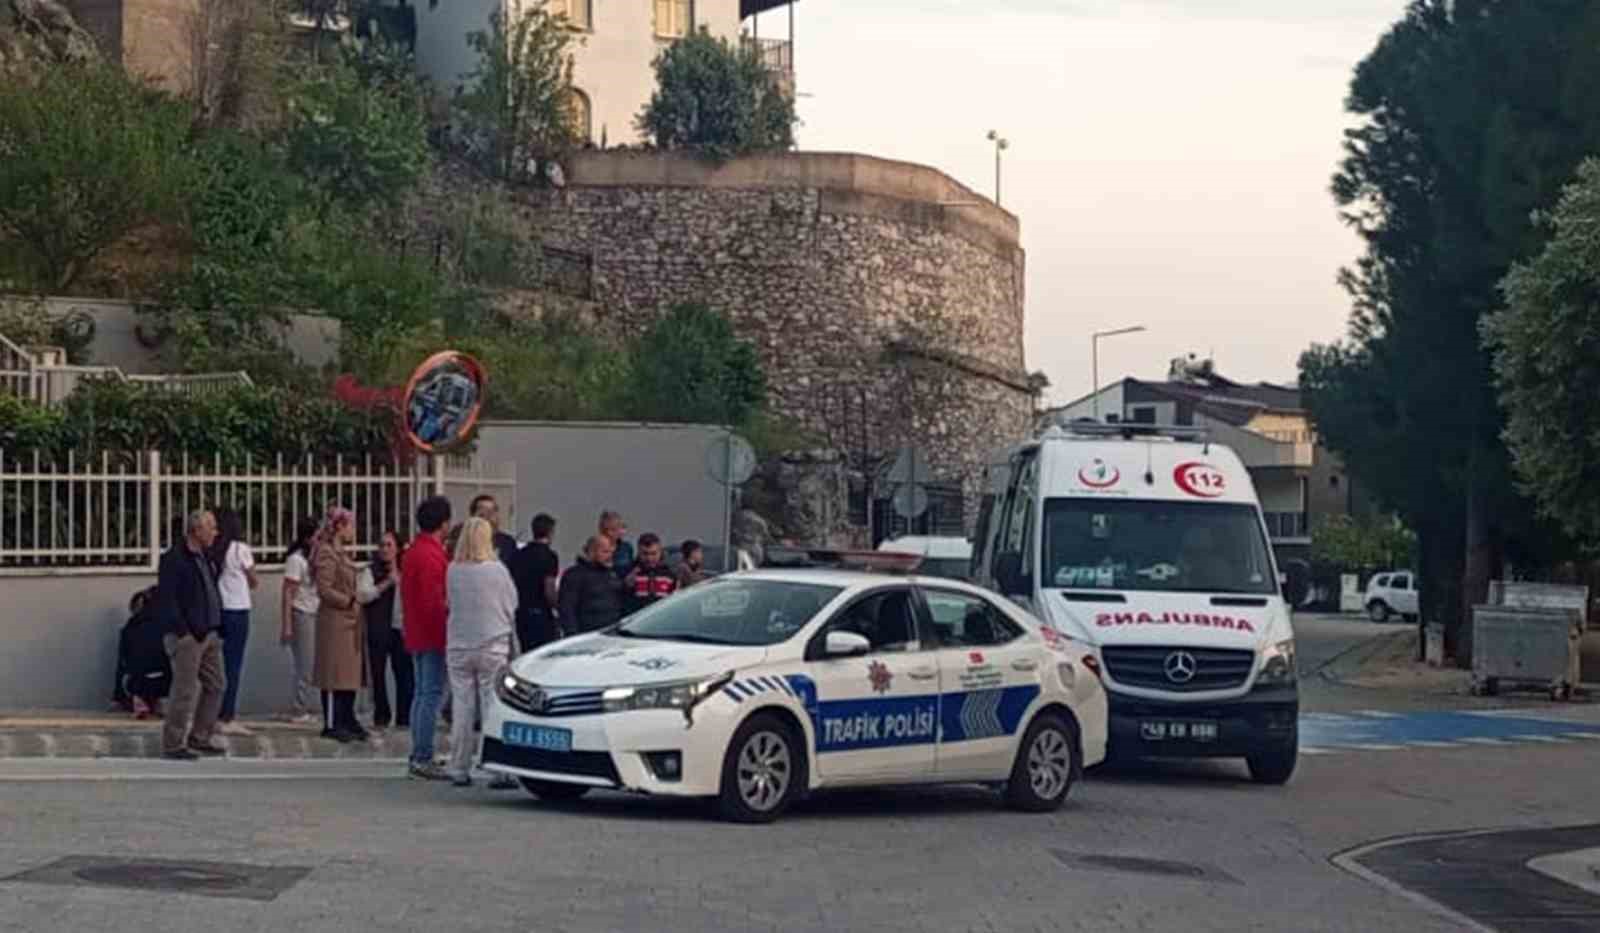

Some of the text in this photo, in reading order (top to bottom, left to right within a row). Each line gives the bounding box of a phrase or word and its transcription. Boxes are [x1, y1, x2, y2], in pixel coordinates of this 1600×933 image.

[1188, 472, 1225, 488] 112
[824, 705, 933, 743] TRAFİK POLİSİ
